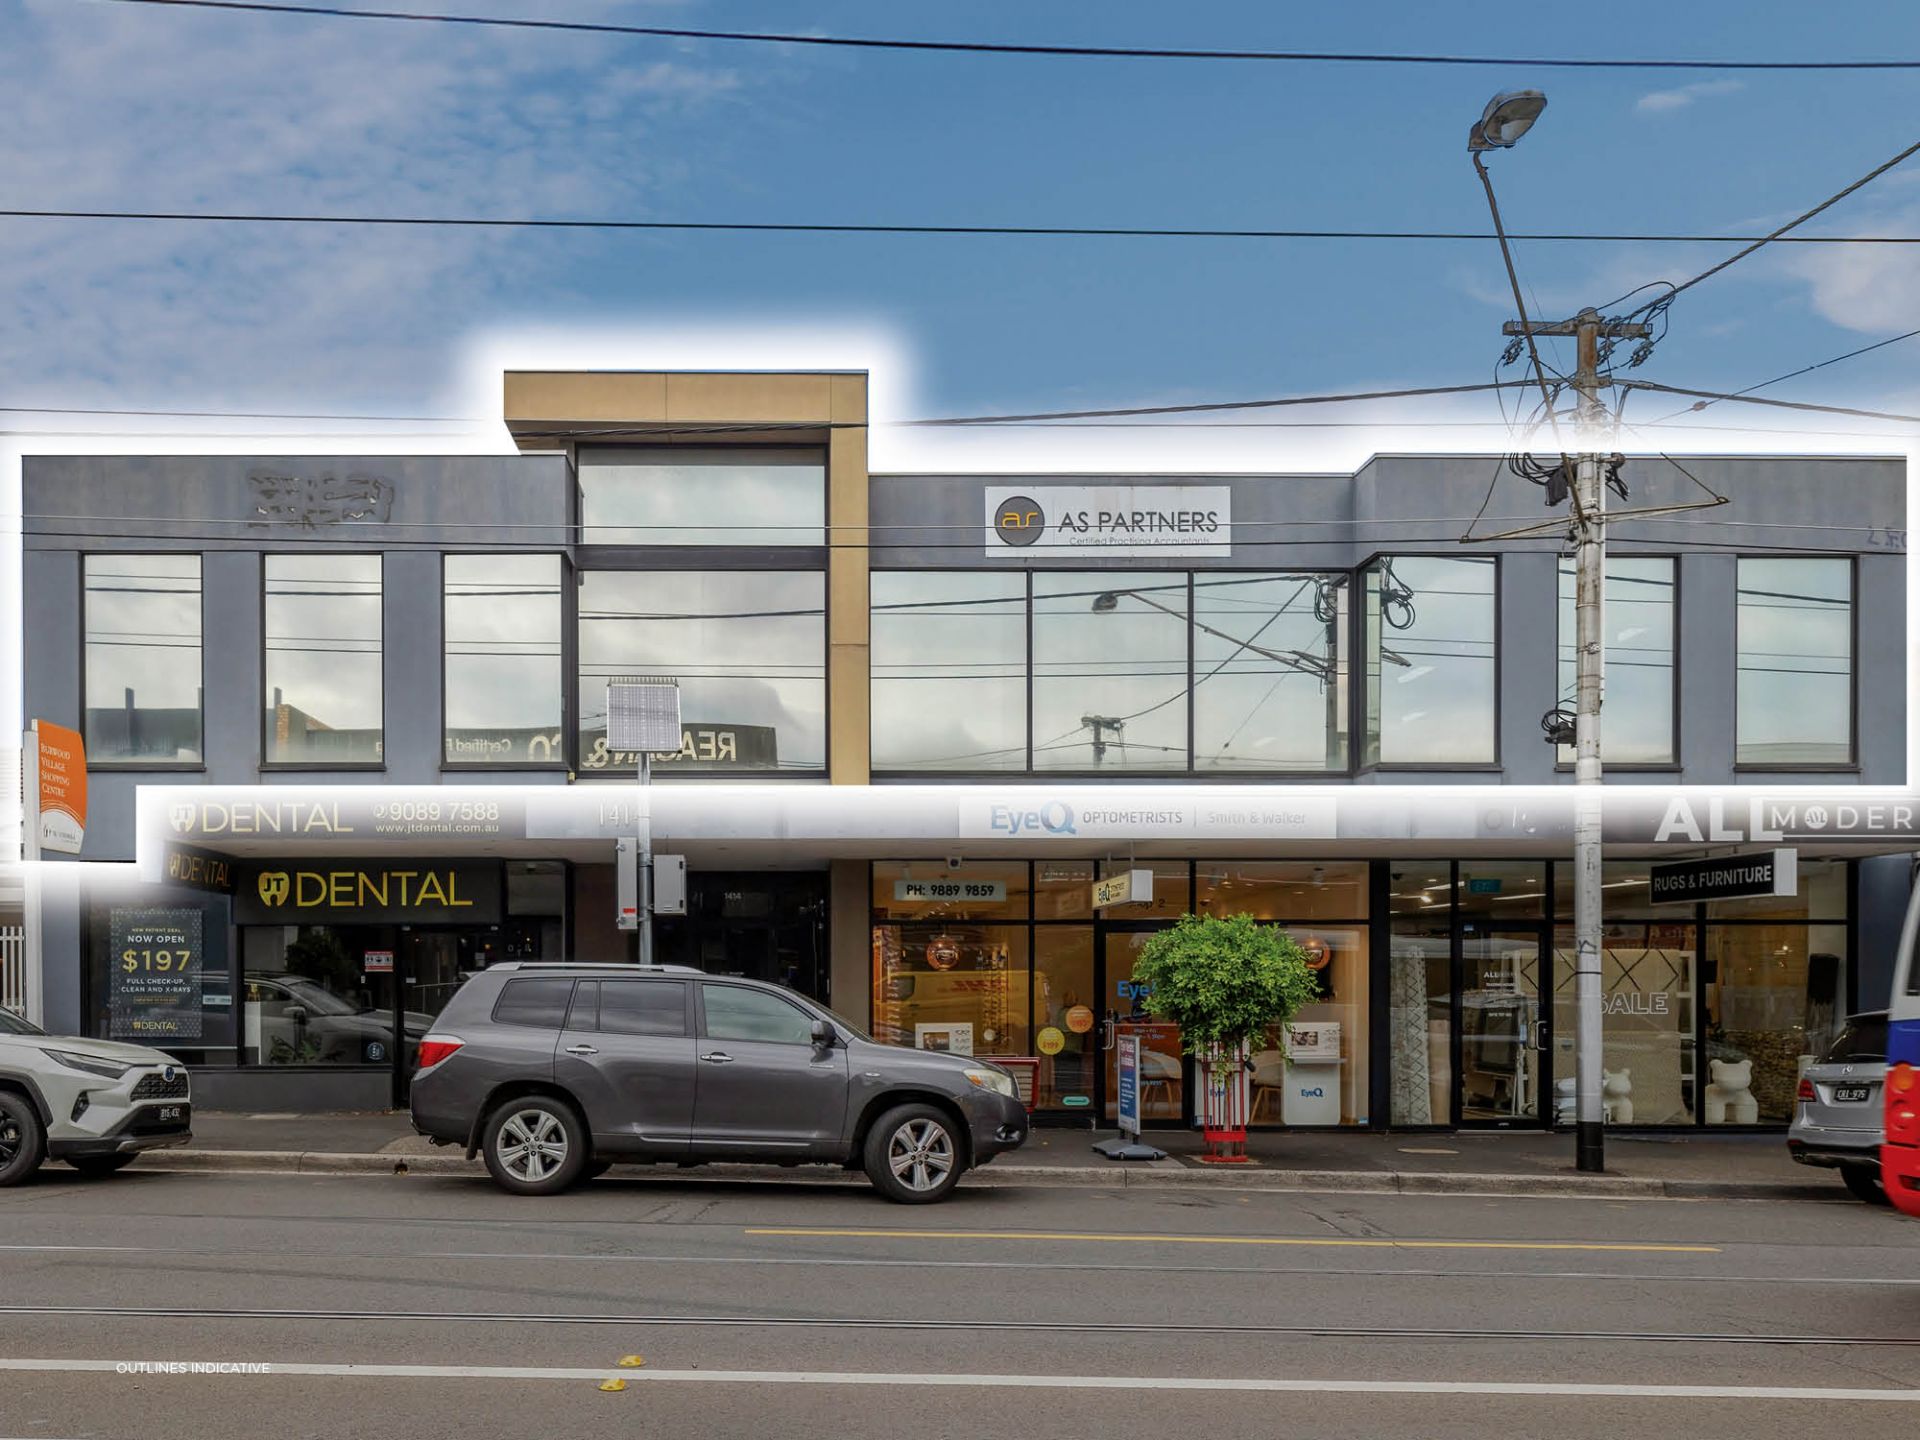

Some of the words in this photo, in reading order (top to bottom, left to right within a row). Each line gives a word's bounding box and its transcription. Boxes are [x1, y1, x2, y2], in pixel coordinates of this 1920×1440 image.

[1058, 511, 1089, 533] AS
[1098, 511, 1218, 533] PARTNERS
[1069, 536, 1107, 545] Certified
[1109, 536, 1152, 546] Practising
[1154, 536, 1210, 545] Accountants
[40, 743, 71, 760] BURWOOD
[202, 803, 354, 833] DENTAL
[390, 802, 441, 821] 9089
[448, 802, 499, 821] 7588
[990, 801, 1077, 834] EyeQ
[1082, 811, 1183, 825] OPTOMETRISTS
[1207, 811, 1245, 825] Smith
[1250, 811, 1258, 825] &
[1263, 811, 1306, 825] Walker
[1654, 796, 1783, 842] ALL
[375, 823, 499, 834] www.jtdental.com.au
[180, 854, 232, 887] DENTAL
[1653, 874, 1686, 892] RUGS
[1688, 874, 1697, 889] &
[1699, 864, 1772, 888] FURNITURE
[263, 877, 285, 893] JT
[296, 871, 473, 907] DENTAL
[906, 884, 925, 896] PH:
[930, 884, 960, 897] 9889
[965, 884, 995, 897] 9859
[127, 935, 153, 943] NOW
[156, 935, 185, 943] OPEN
[122, 949, 191, 973] $197
[141, 1021, 178, 1030] DENTAL
[1301, 1087, 1324, 1097] EyeQ
